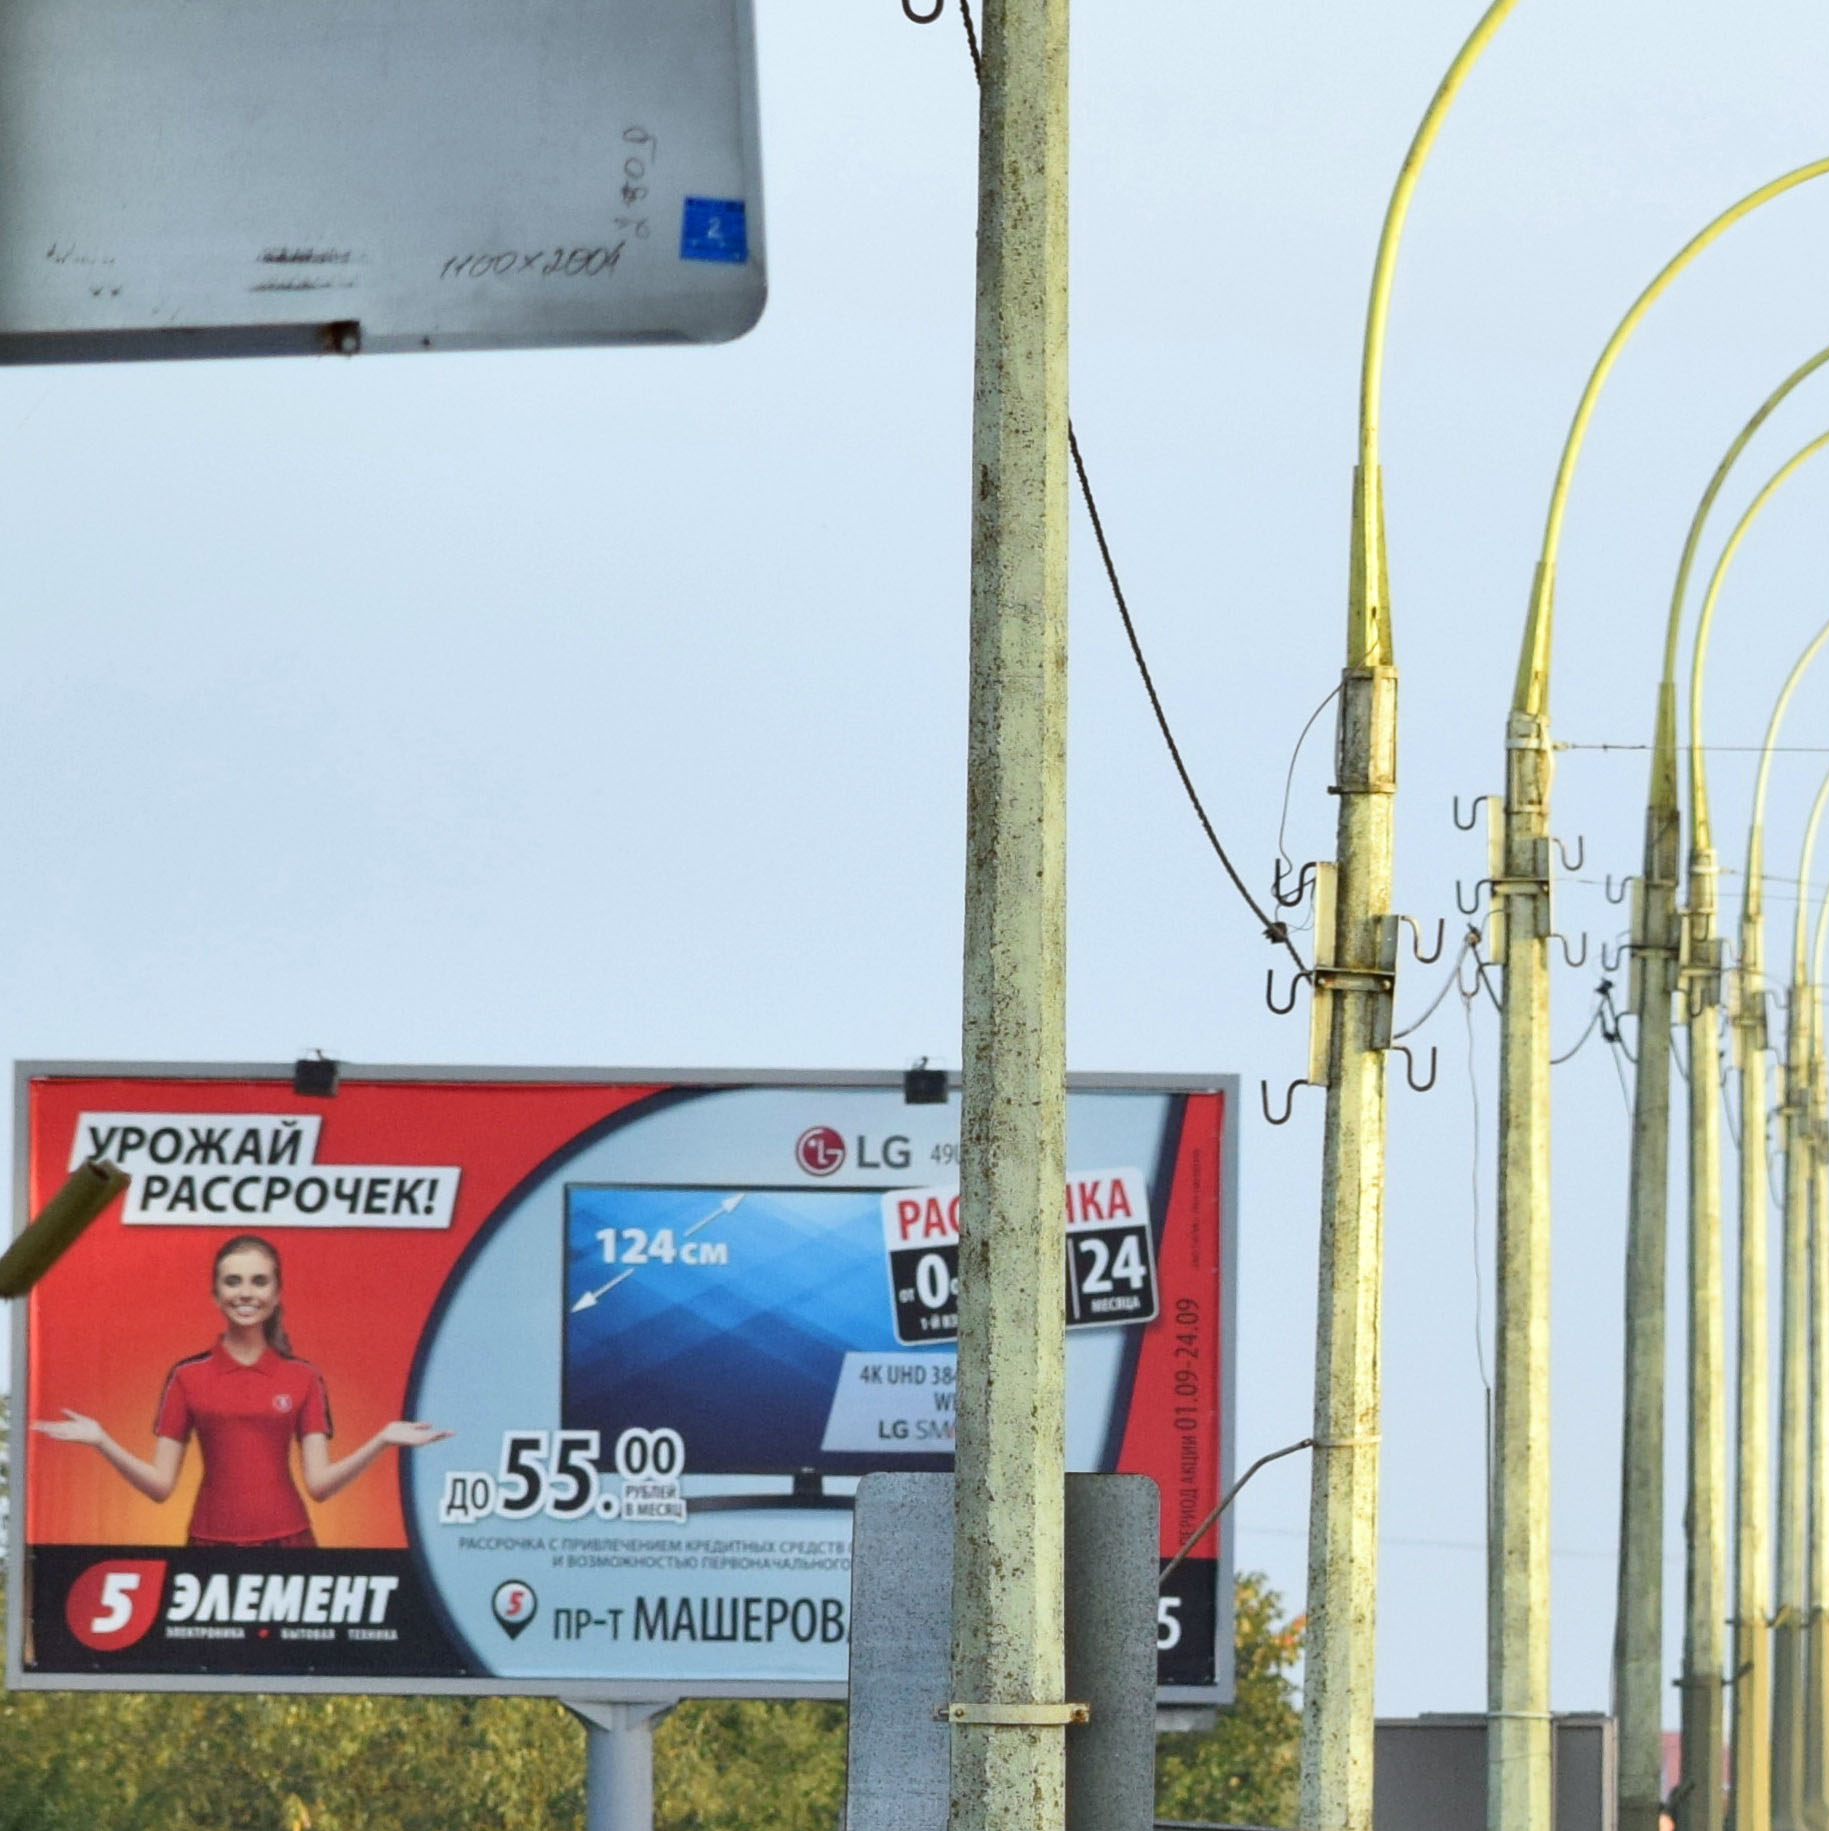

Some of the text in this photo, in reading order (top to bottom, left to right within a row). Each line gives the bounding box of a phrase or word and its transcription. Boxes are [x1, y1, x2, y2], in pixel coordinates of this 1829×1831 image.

[89, 1121, 303, 1165] УРОЖАЙ
[857, 1135, 912, 1169] LG
[141, 1175, 440, 1215] РАССРОЧЕК!
[596, 1228, 677, 1264] 124
[1078, 1234, 1147, 1294] 24
[887, 1365, 928, 1385] UHD
[878, 1420, 909, 1440] LG
[1180, 1435, 1199, 1484] АКЦИИ
[625, 1484, 678, 1500] РУБЛЕЙ
[637, 1502, 685, 1519] МЕСЯЦ
[459, 1537, 843, 1555] РАССРОЧКА С ПРИВЛЕЧЕНИЕМ КРЕДИТНЫХ СРЕДСТВ
[567, 1556, 698, 1570] ВОЗМОЖНОСТЬЮ
[90, 1573, 399, 1633] 5 ЭЛЕМЕНТ
[633, 1596, 851, 1644] МАШЕРОВ
[165, 1626, 399, 1641] ЭЛЕКТРОНИКА БЫТОВАЯ ТЕХНИКА
